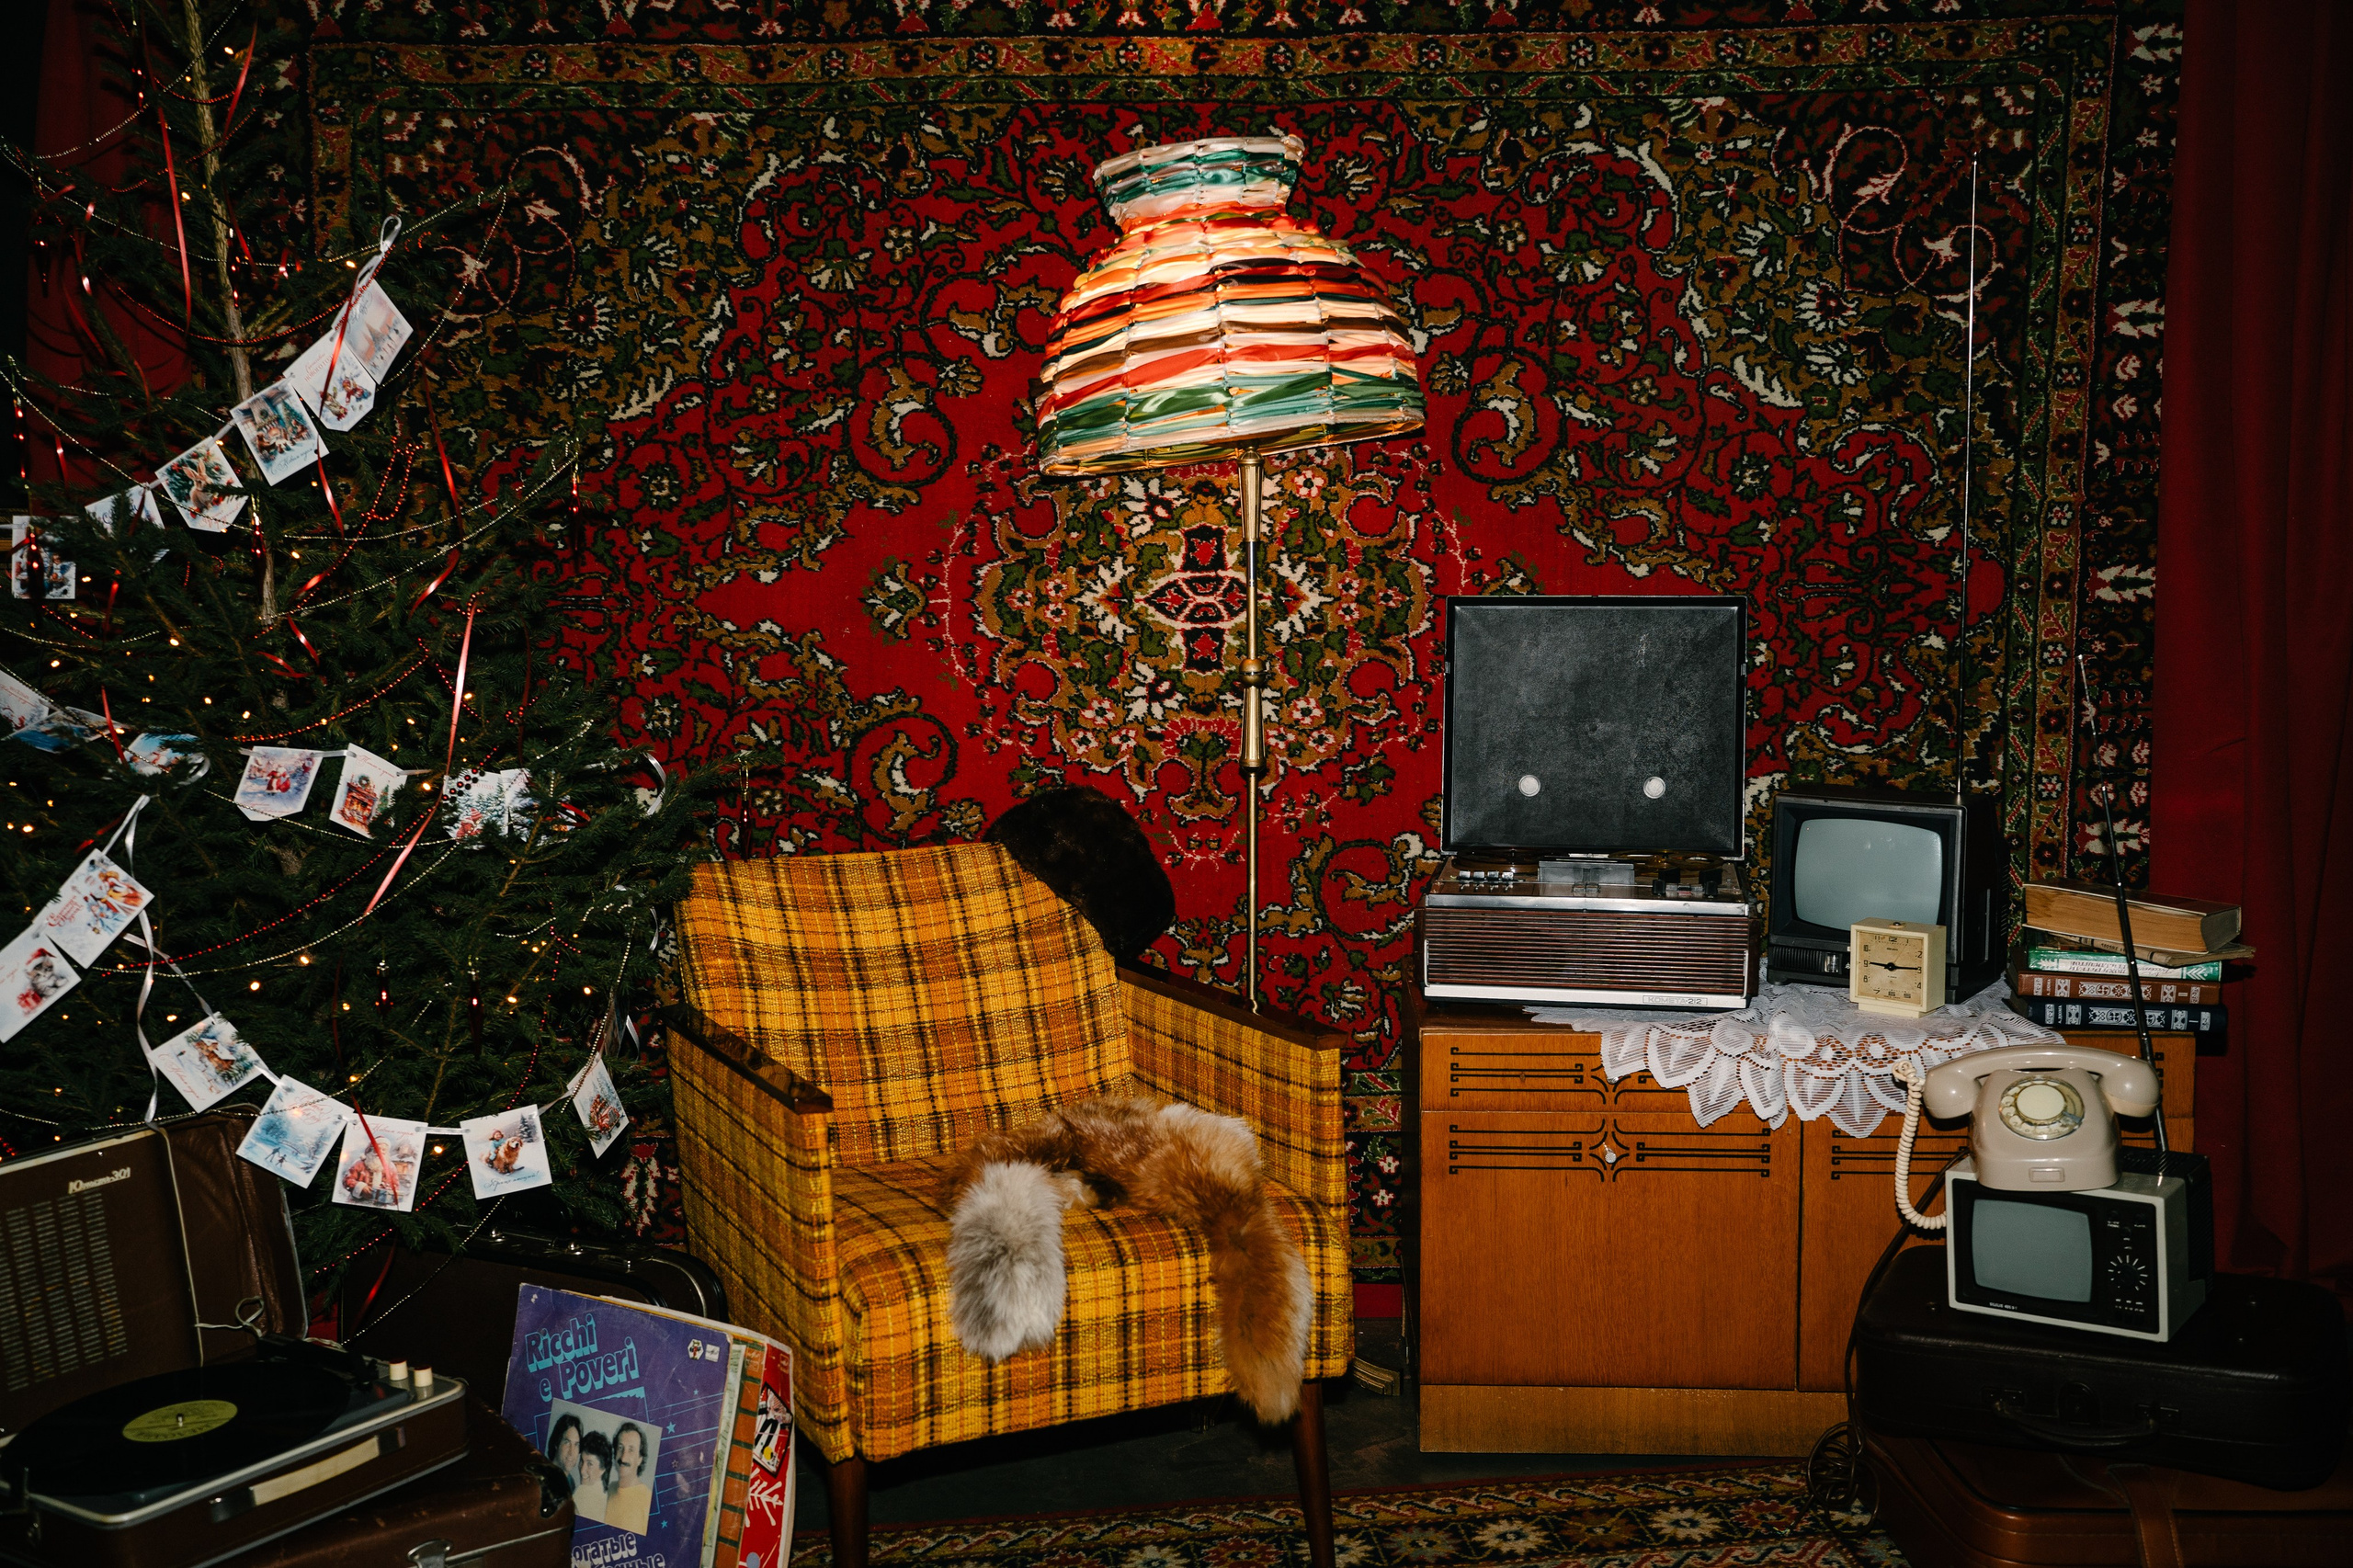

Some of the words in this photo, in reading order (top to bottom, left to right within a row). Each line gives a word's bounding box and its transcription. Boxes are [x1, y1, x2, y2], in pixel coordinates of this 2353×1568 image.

[525, 1312, 598, 1373] Ricchi
[539, 1378, 553, 1403] e
[558, 1335, 640, 1401] Poveri
[571, 1532, 638, 1566] огатые
